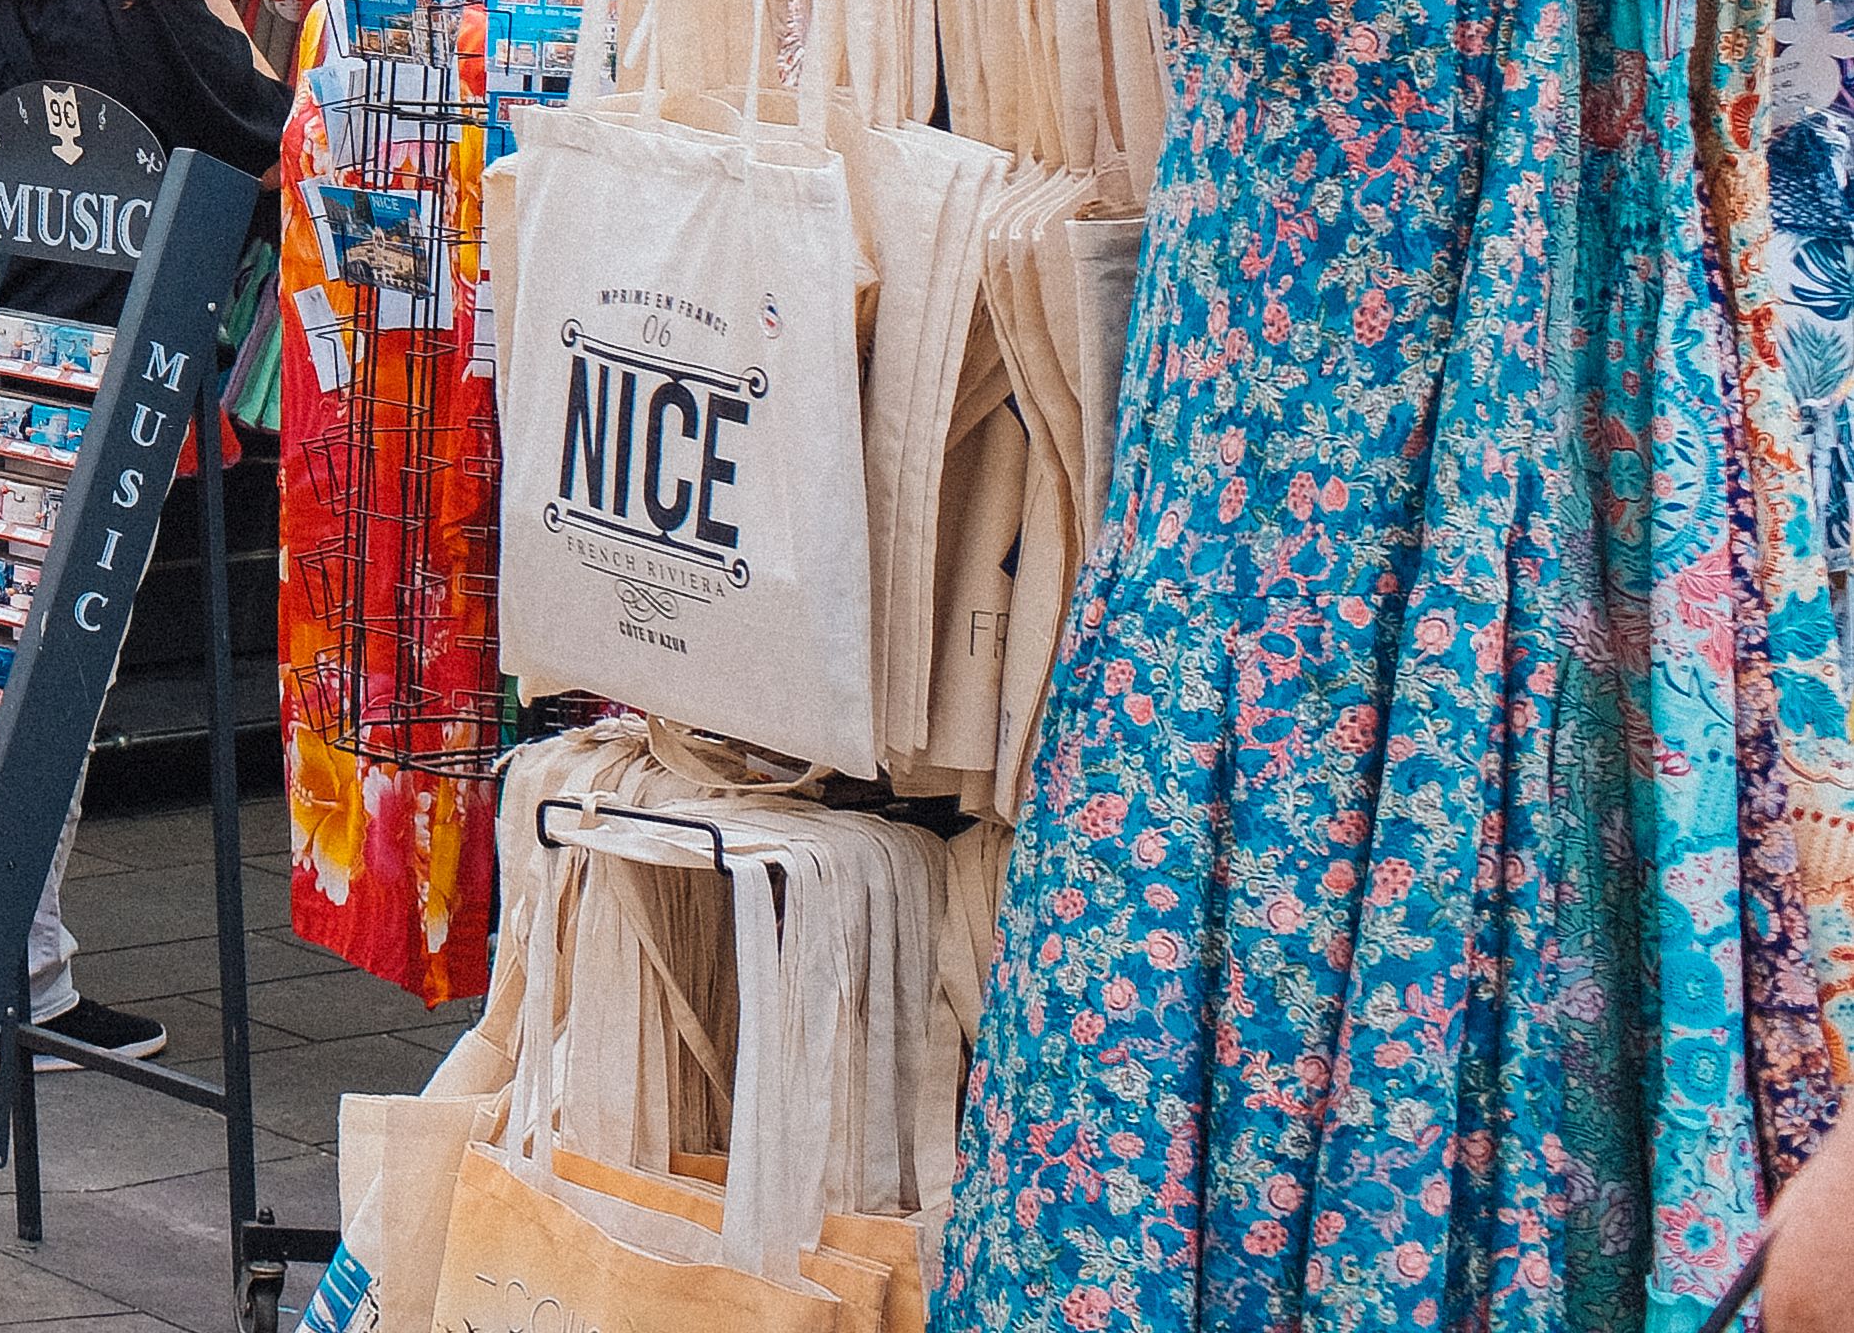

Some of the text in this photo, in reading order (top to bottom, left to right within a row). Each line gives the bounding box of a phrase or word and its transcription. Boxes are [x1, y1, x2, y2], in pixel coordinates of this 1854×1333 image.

[50, 98, 77, 128] 9€
[370, 194, 401, 212] NICE
[642, 313, 672, 348] 06
[655, 292, 674, 311] EN
[679, 298, 729, 338] FRANCE
[558, 354, 751, 550] NICE
[74, 339, 191, 632] MUSIC
[566, 535, 727, 598] FRENCH RIVIERA
[647, 628, 688, 655] D'AZUR
